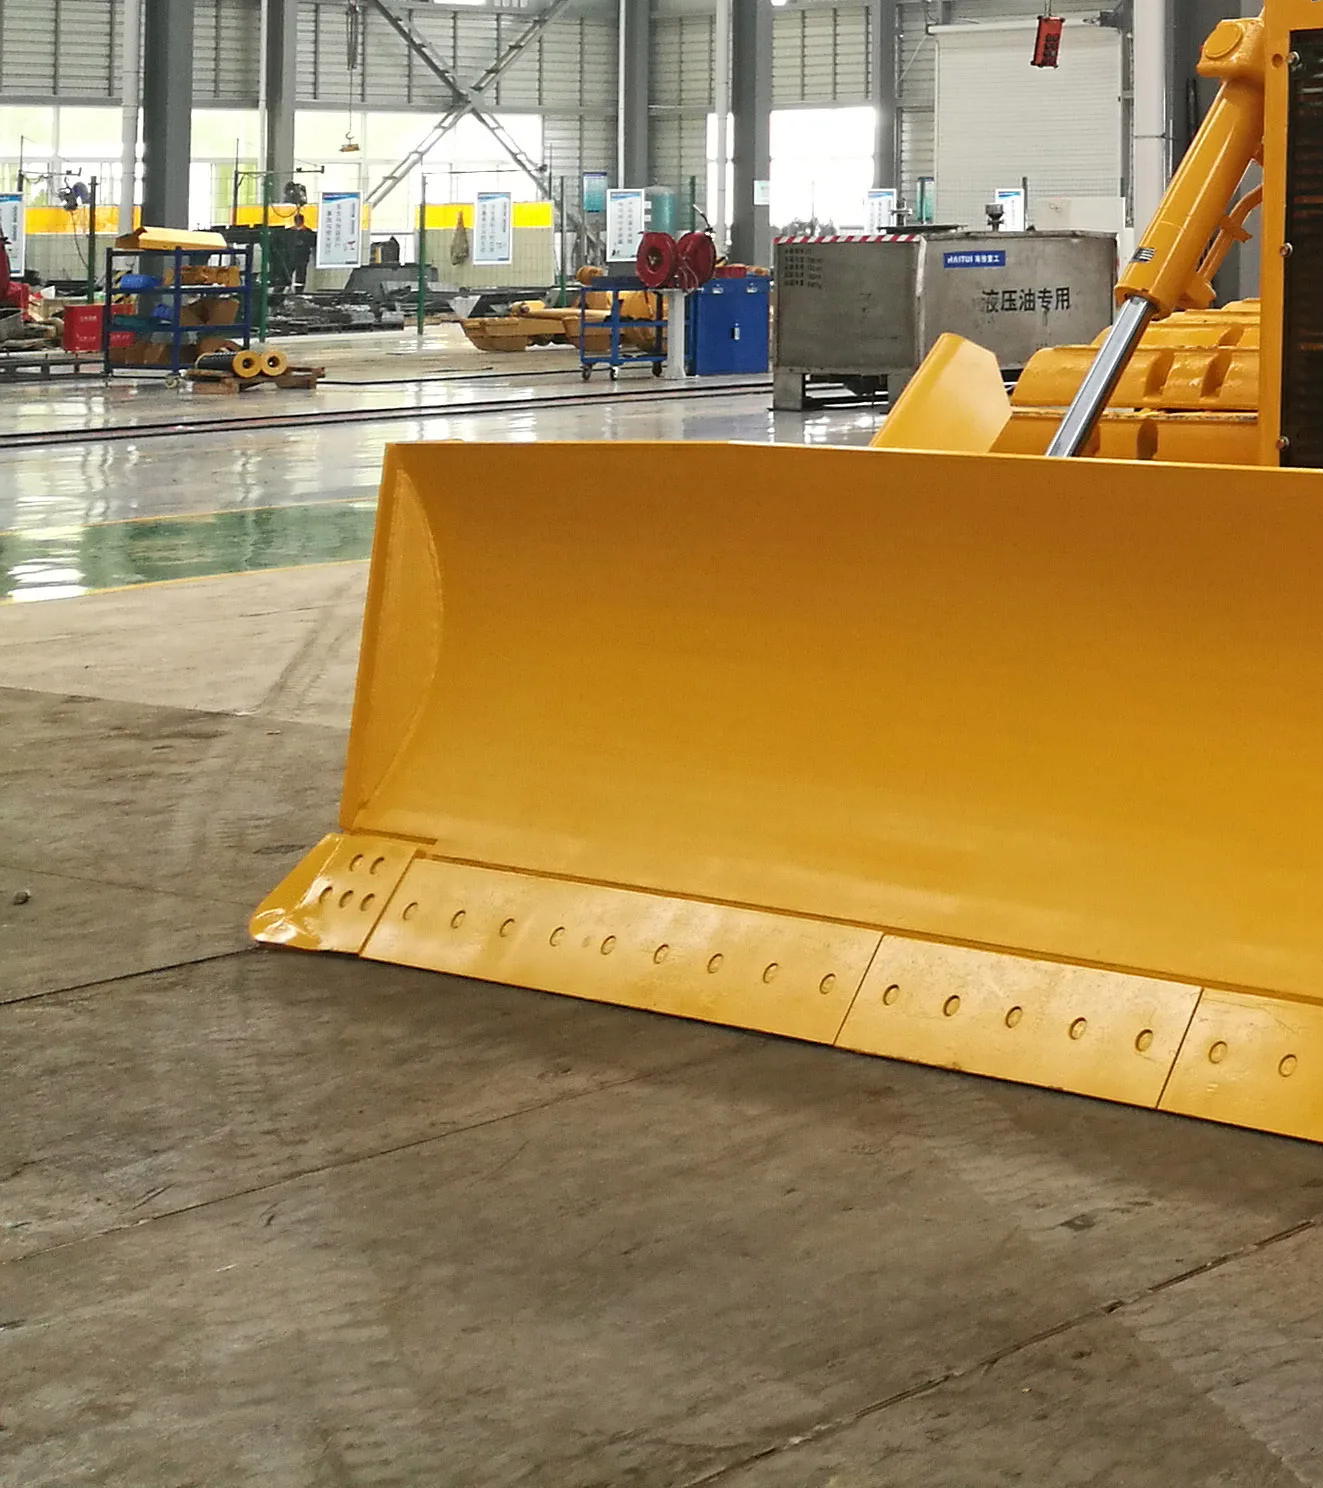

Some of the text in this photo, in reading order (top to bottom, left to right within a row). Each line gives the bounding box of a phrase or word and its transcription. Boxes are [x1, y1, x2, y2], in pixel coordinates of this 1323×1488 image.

[981, 287, 1071, 313] 液压油专用
